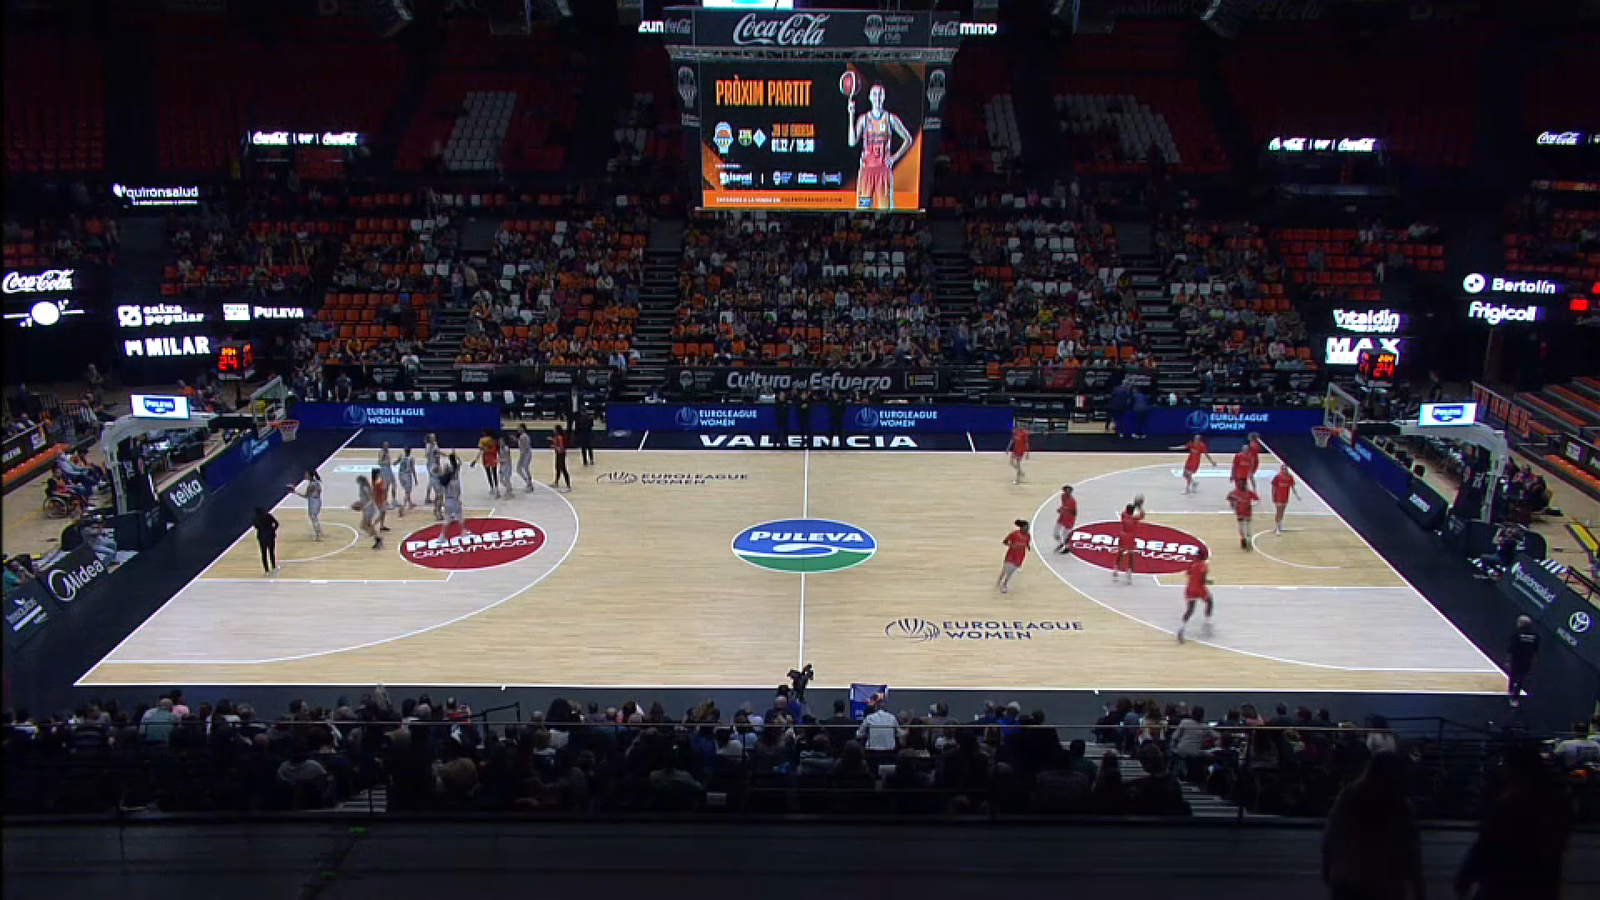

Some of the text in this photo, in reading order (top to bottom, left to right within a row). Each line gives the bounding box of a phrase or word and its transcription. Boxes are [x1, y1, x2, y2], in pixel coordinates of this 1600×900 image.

[733, 13, 829, 46] Coca-Cola
[716, 74, 813, 106] PRÒXIM PARTIT
[2, 268, 74, 294] Coca-Cola
[1492, 277, 1556, 294] Bertolín
[144, 311, 204, 326] popular
[252, 306, 304, 319] PULEVA
[1468, 301, 1537, 325] Frigicoll
[145, 336, 210, 357] MILAR
[219, 355, 238, 371] 24
[1373, 362, 1394, 378] 24
[726, 370, 791, 389] Cultura
[808, 371, 892, 391] Esfuerzo
[366, 407, 425, 416] EUROLEAGUE
[699, 409, 758, 419] EUROLEAGUE
[879, 410, 938, 419] EUROLEAGUE
[1210, 412, 1269, 422] EUROLEAGUE
[367, 415, 404, 424] WOMEN
[699, 418, 736, 427] WOMEN
[879, 419, 916, 428] WOMEN
[1210, 422, 1246, 431] WOMEN
[699, 434, 918, 448] VALENCIA
[641, 472, 749, 480] EUROLEAGUE
[405, 527, 536, 552] PAMESA
[749, 531, 864, 542] PULEVA
[47, 559, 105, 602] Midea
[942, 620, 1084, 631] EUROLEAGUE
[945, 630, 1032, 640] WOMEN
